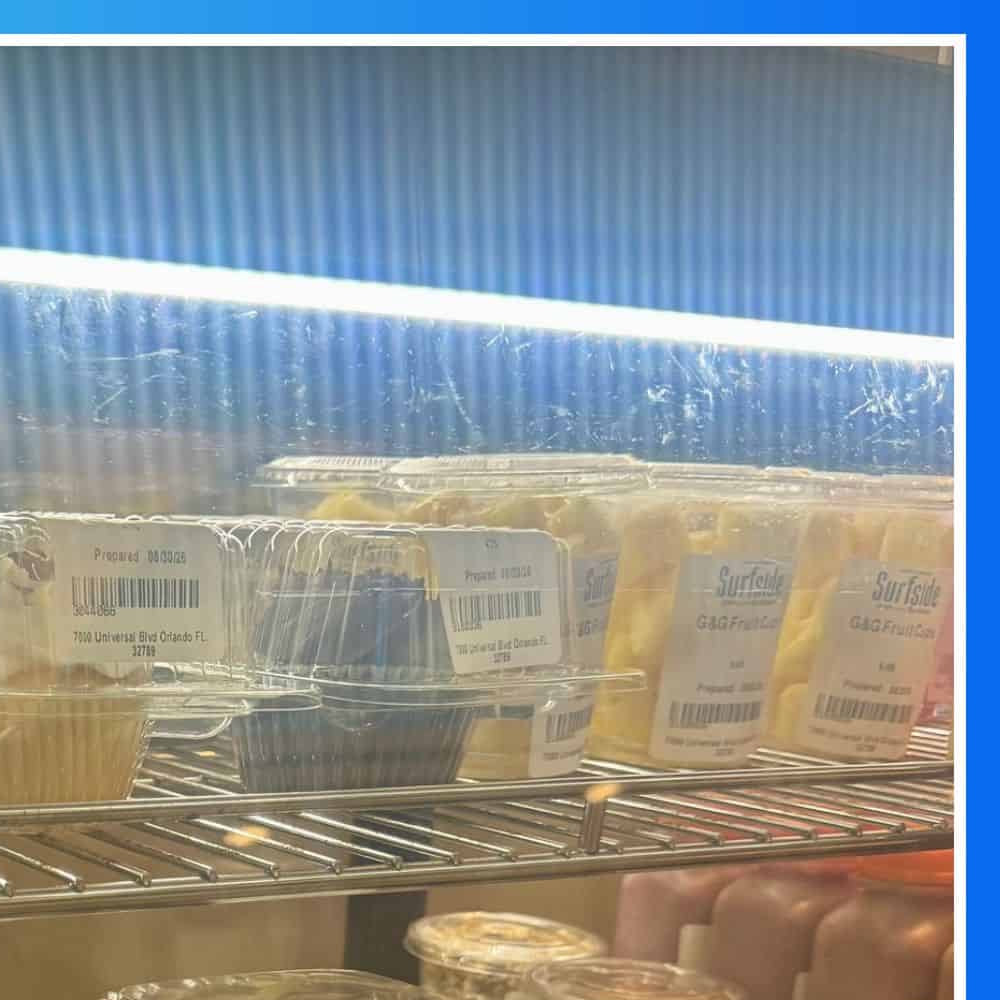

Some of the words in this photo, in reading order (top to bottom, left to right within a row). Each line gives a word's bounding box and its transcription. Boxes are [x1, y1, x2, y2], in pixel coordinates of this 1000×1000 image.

[94, 547, 139, 564] Prepared
[717, 565, 785, 599] Surfside
[872, 570, 941, 608] Surfside
[95, 631, 136, 643] Universal
[139, 631, 158, 643] Blvd
[159, 631, 193, 643] Orlando
